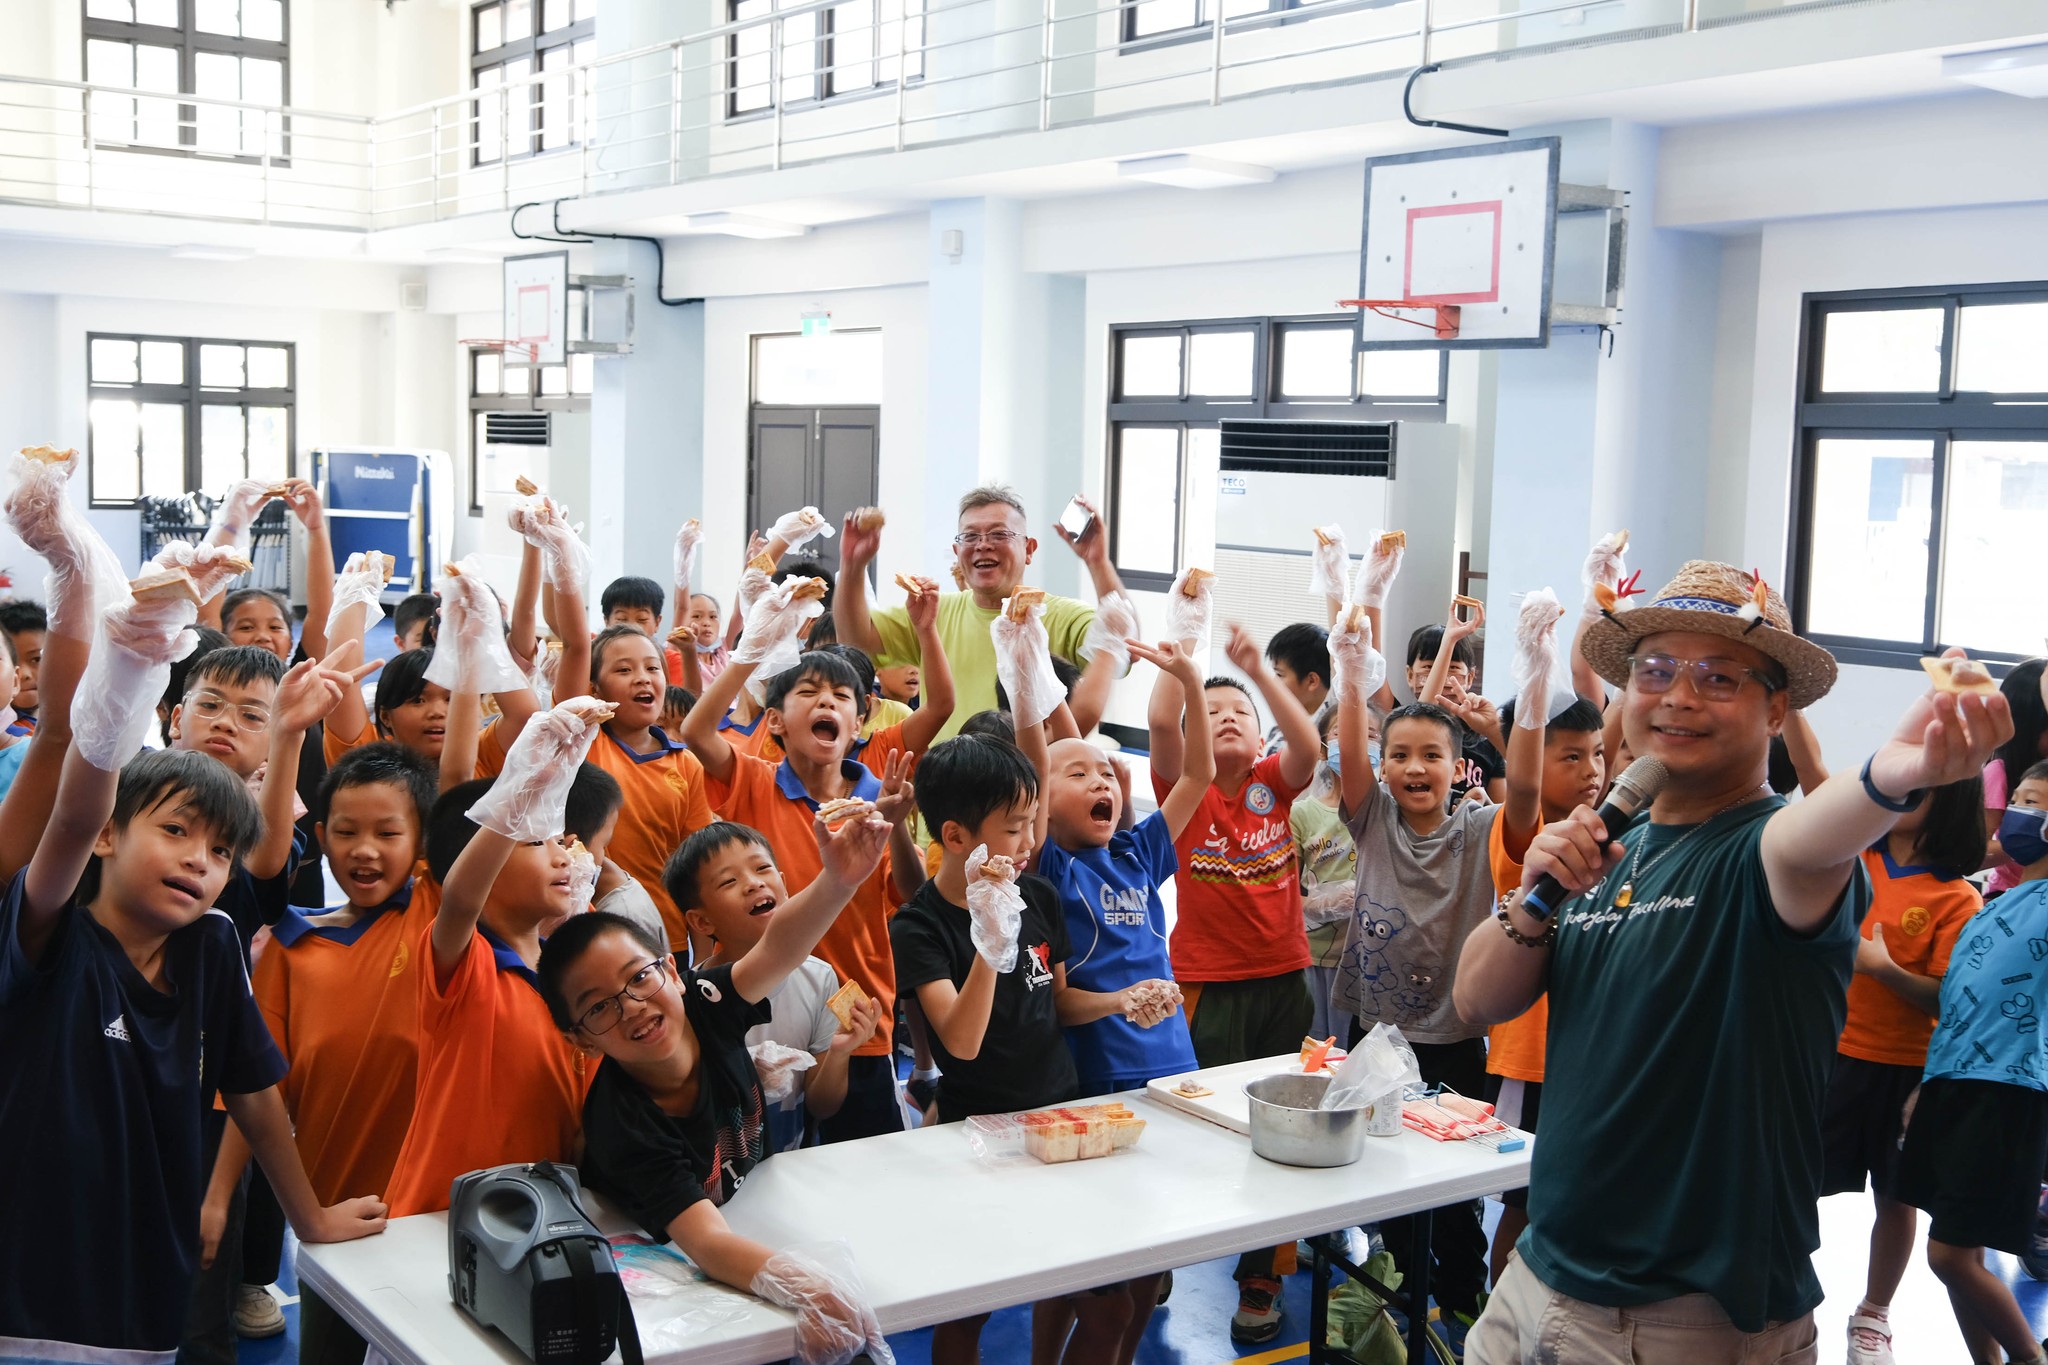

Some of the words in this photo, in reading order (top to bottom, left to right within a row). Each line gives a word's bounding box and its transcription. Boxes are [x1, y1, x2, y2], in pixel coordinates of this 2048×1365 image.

[1222, 478, 1246, 487] TECO
[1104, 912, 1145, 926] SPOR
[104, 1028, 131, 1042] adida
